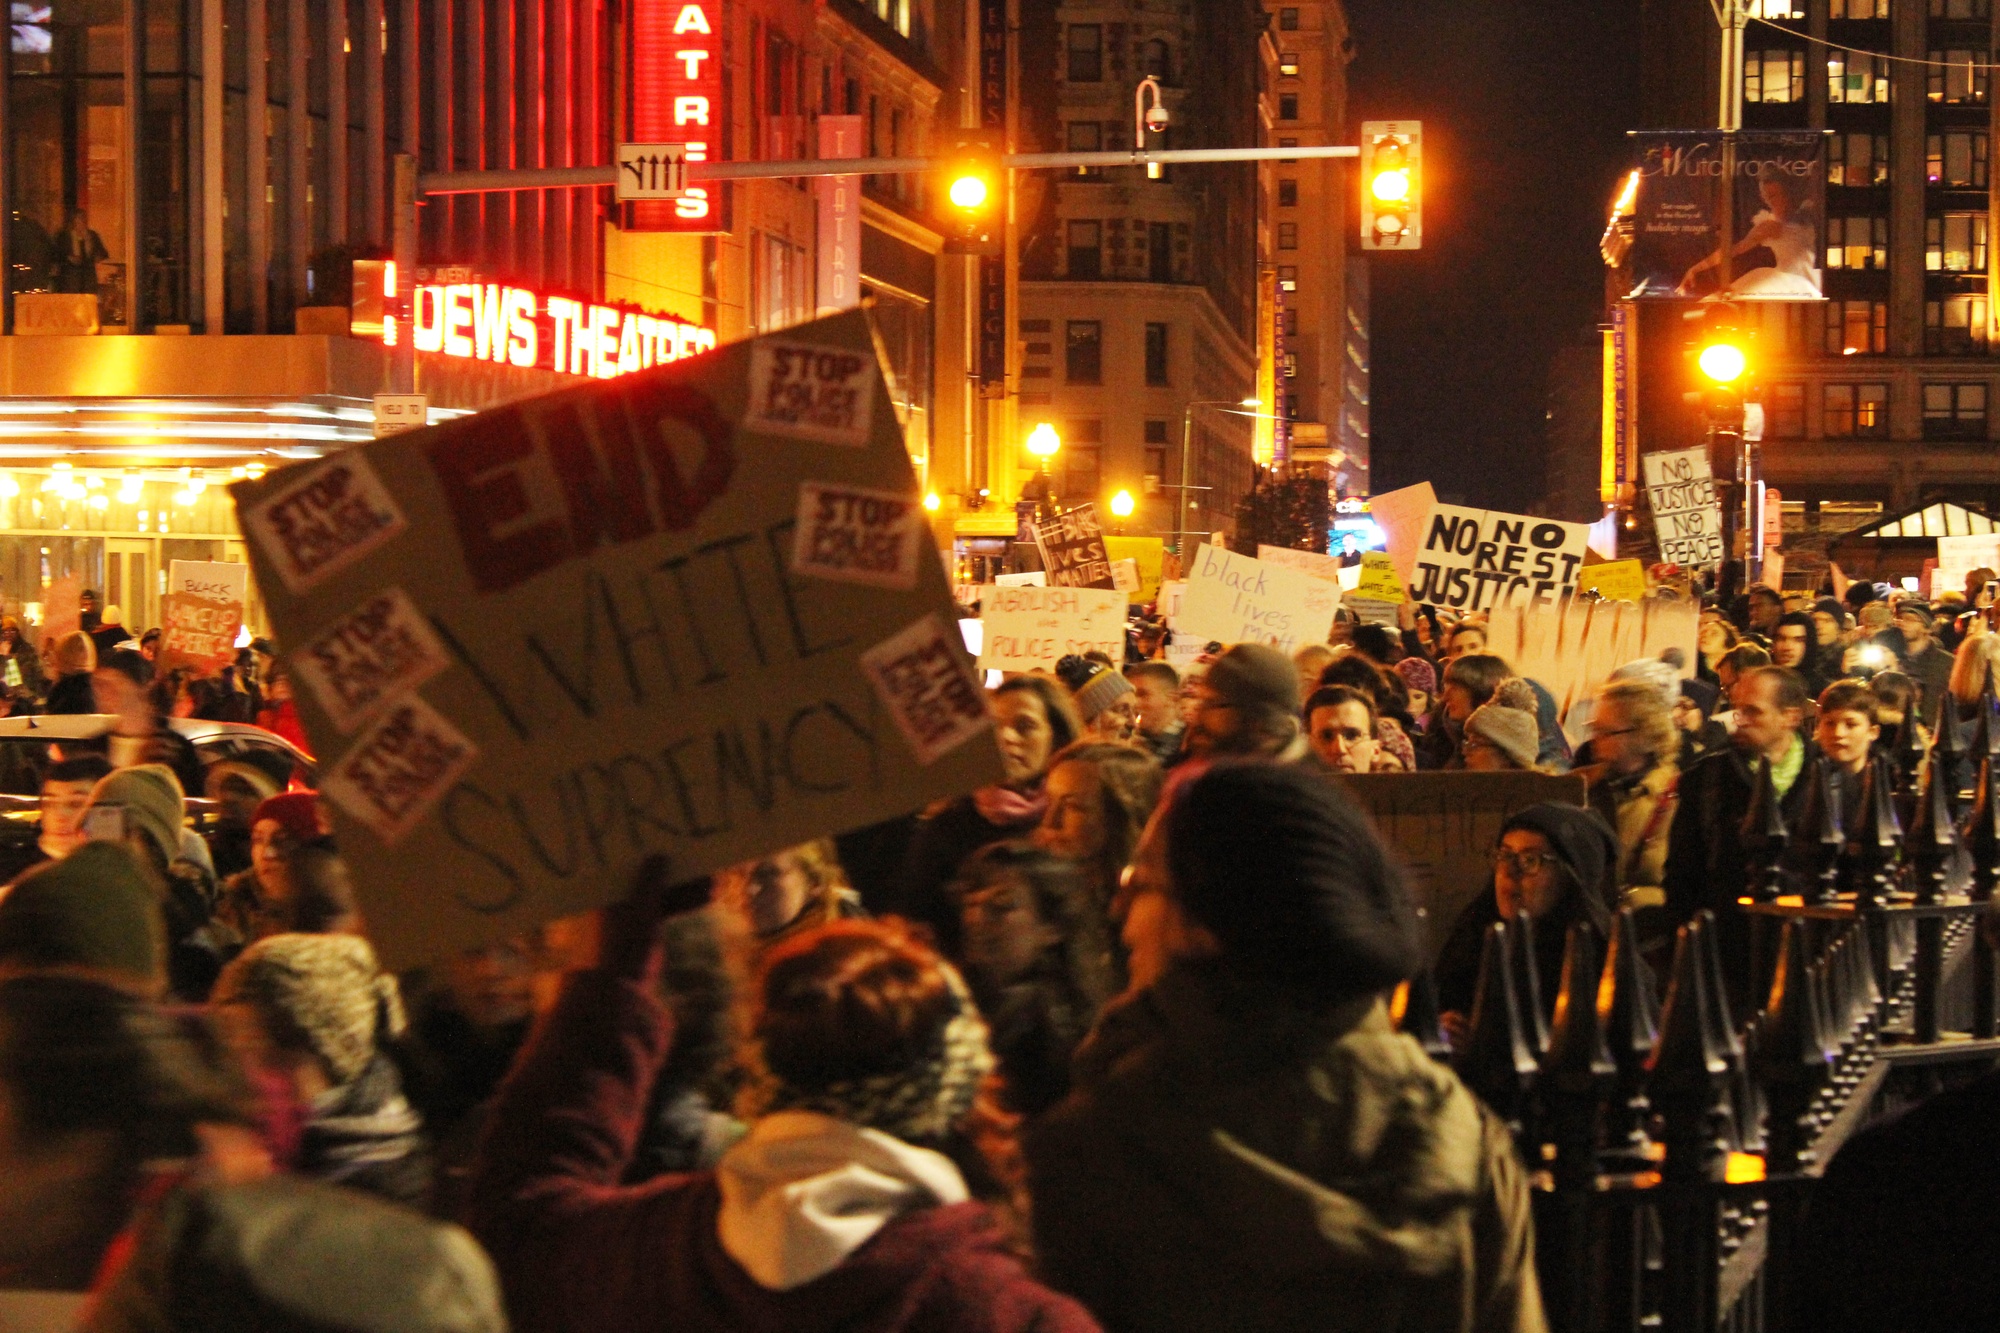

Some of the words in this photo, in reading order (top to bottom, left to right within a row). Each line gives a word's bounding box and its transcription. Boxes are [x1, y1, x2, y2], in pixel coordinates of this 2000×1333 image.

[833, 131, 846, 299] TATRO
[1275, 293, 1285, 367] EMERSON
[1275, 377, 1285, 451] COLLEGE
[1661, 456, 1693, 482] NO
[423, 382, 737, 594] END
[1652, 480, 1714, 511] JUSTICE
[1425, 514, 1479, 556] NO
[1493, 520, 1566, 549] NO
[1672, 512, 1704, 535] NO
[1665, 536, 1721, 564] PEACE
[185, 579, 232, 596] BLACK
[1202, 548, 1269, 596] black
[989, 590, 1081, 613] ABOLISH
[1231, 591, 1293, 631] lives
[990, 635, 1056, 660] POLICE
